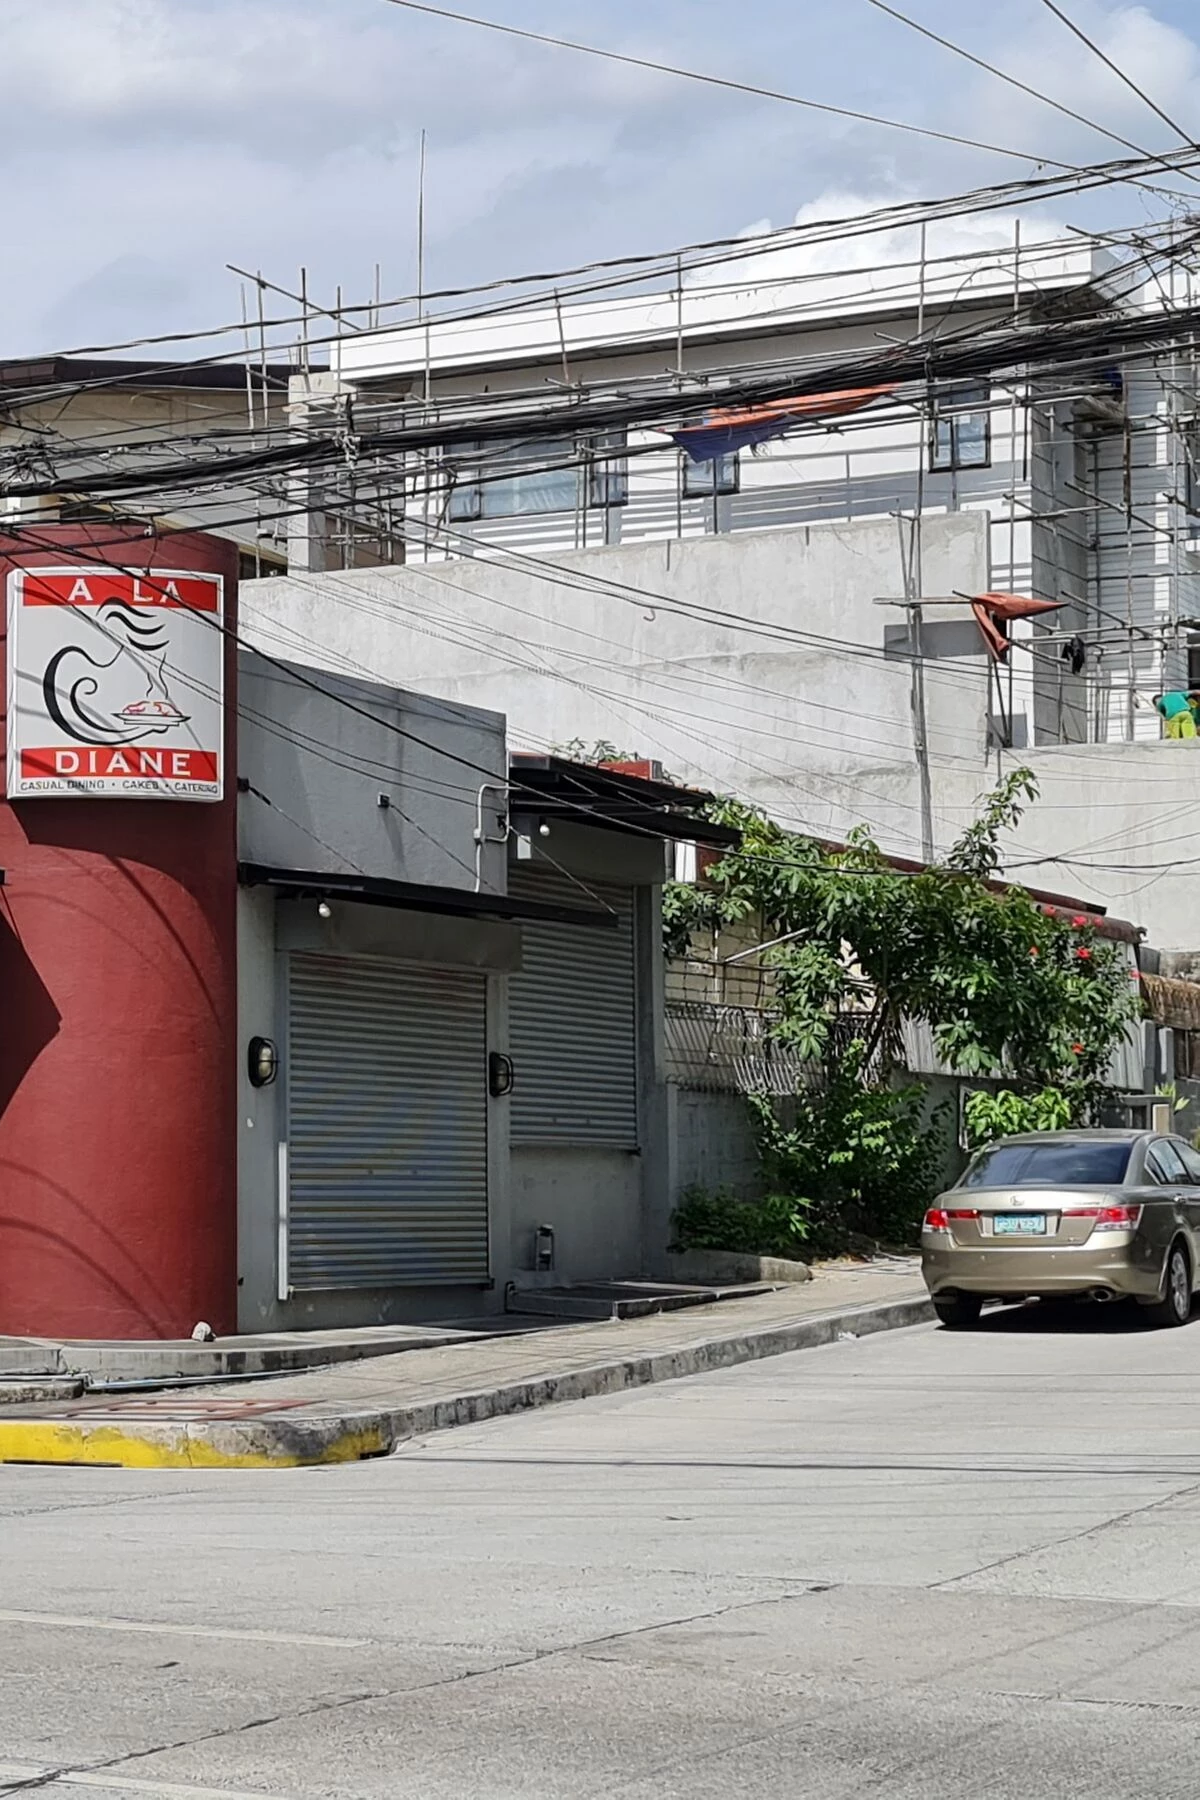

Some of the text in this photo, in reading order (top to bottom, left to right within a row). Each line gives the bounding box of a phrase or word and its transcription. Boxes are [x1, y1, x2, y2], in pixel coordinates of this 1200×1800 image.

[67, 578, 184, 603] A LA
[55, 750, 191, 776] DIANE
[20, 780, 218, 794] CASUAL DINING CAKES CATERING
